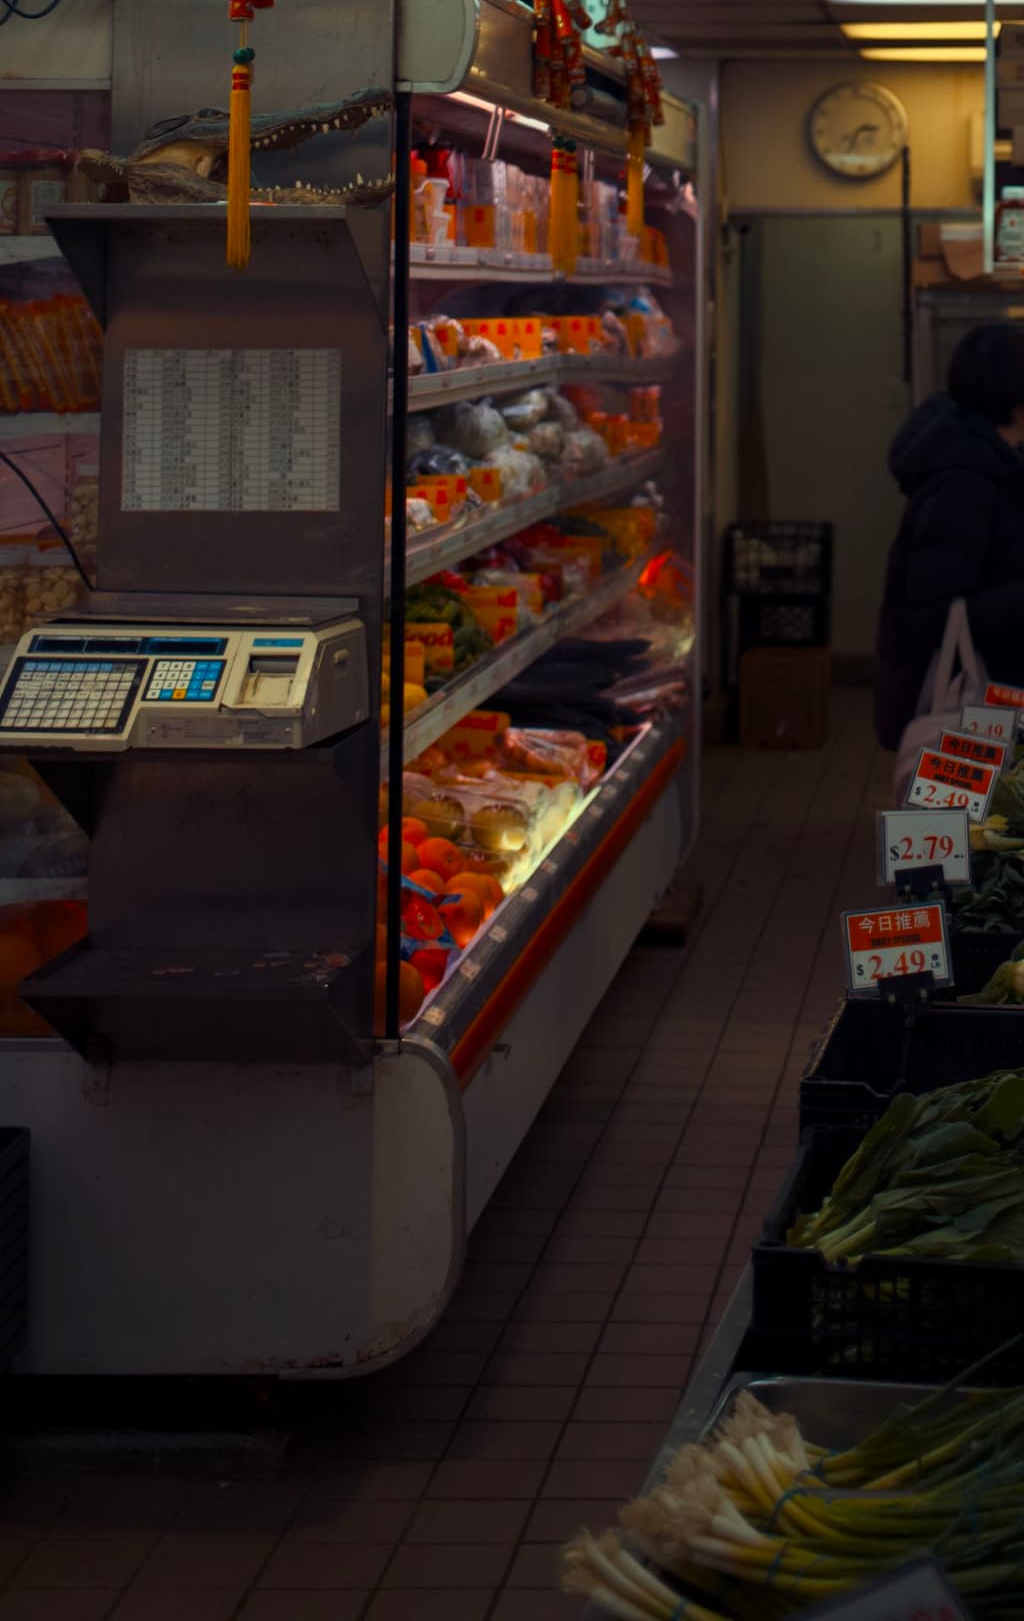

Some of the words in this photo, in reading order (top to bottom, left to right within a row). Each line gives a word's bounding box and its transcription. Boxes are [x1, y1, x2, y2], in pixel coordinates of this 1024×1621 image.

[890, 835, 955, 861] $2.79
[858, 909, 931, 935] 今日推薦
[868, 949, 926, 981] 2.49
